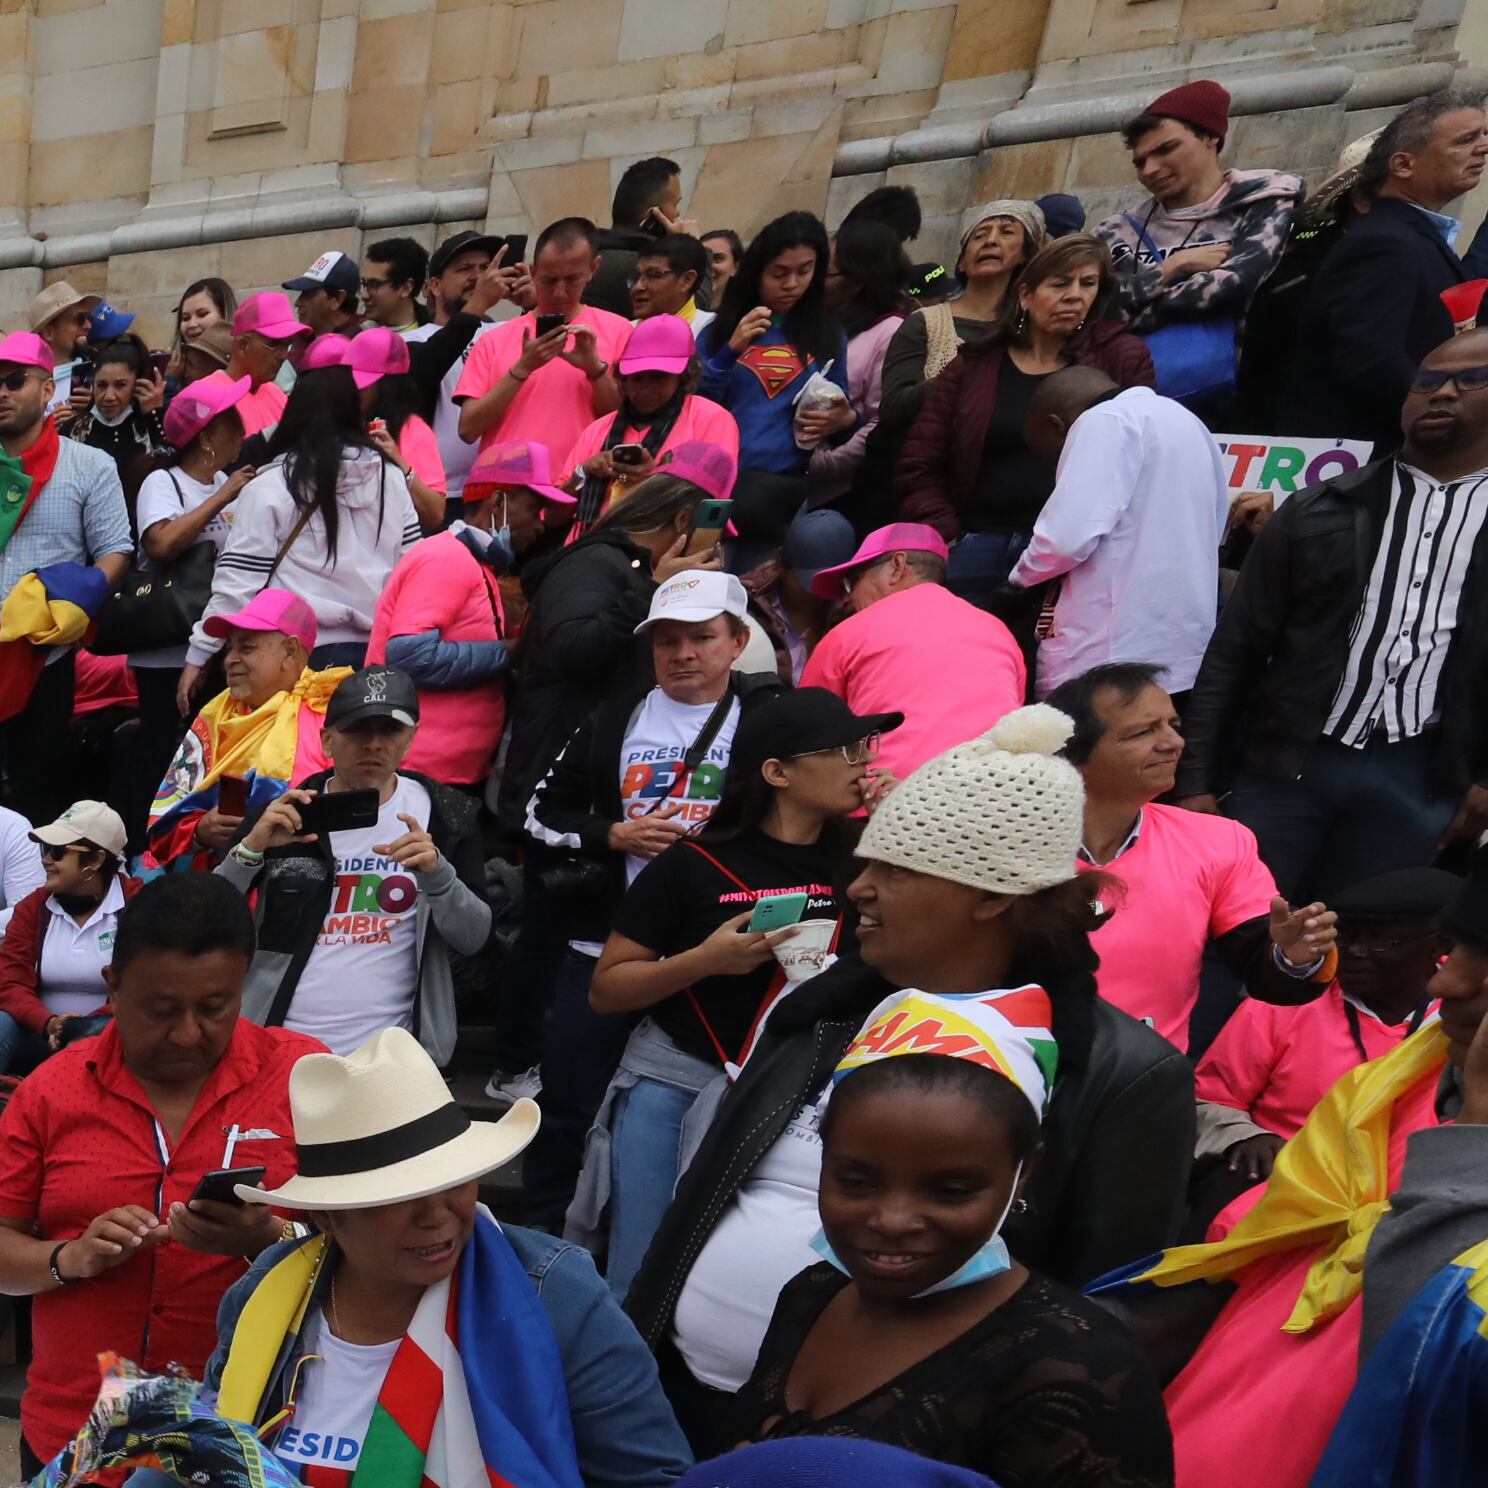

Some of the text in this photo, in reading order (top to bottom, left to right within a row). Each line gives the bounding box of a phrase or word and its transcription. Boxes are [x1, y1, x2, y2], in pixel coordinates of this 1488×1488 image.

[1224, 441, 1360, 491] TRO
[363, 694, 386, 704] CALI
[334, 873, 418, 914] TRO
[807, 898, 832, 910] Petro
